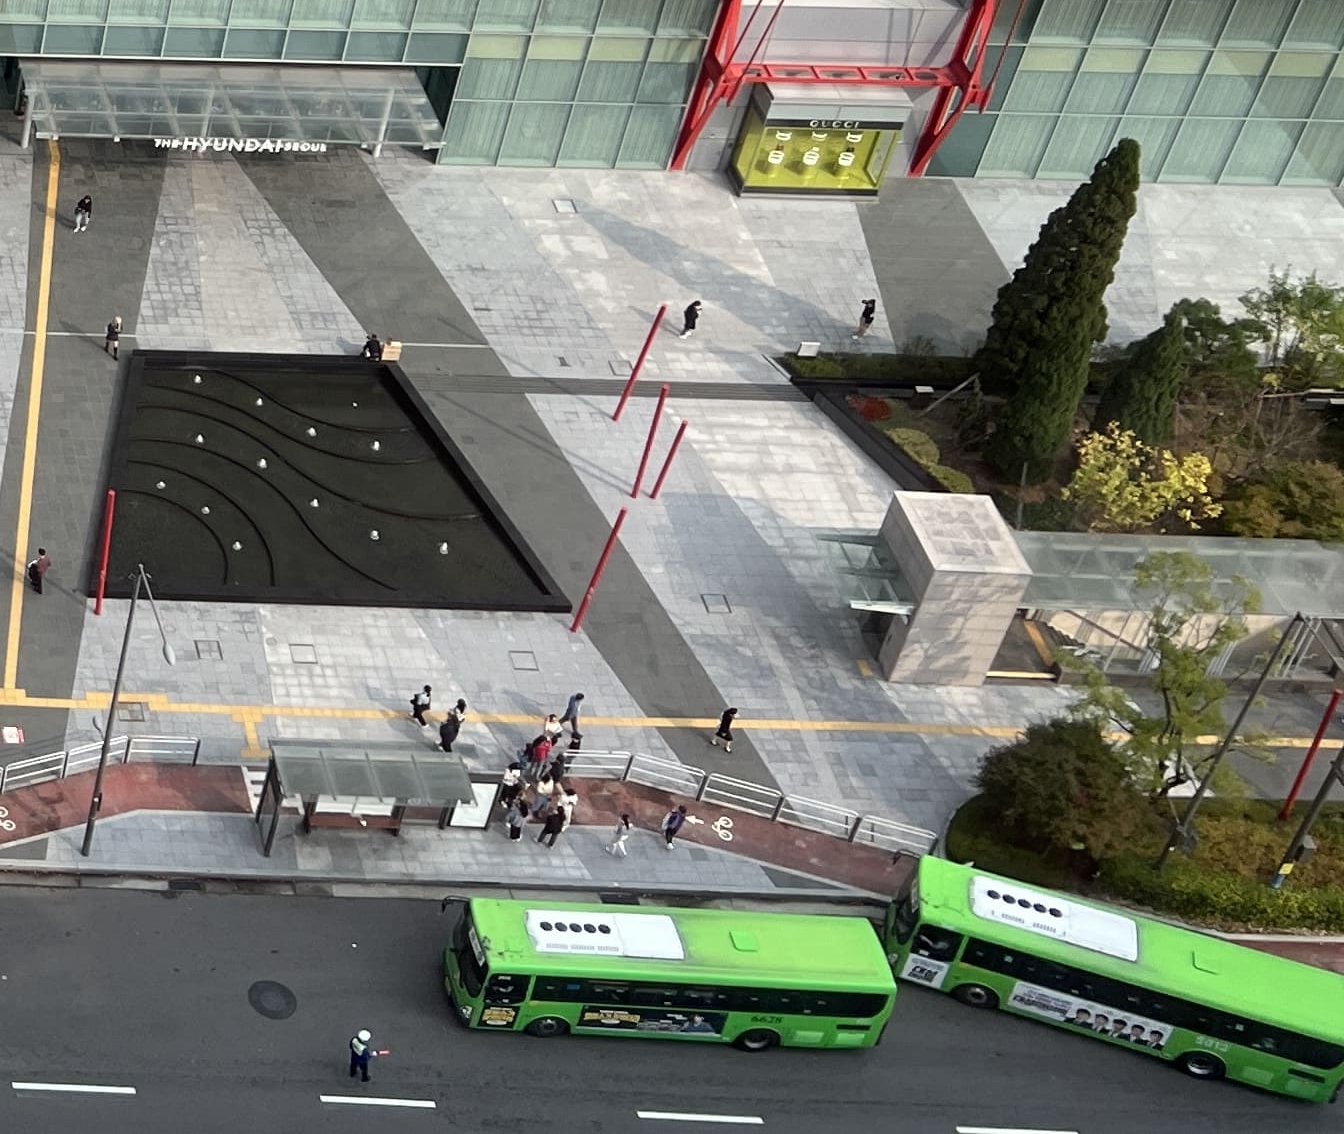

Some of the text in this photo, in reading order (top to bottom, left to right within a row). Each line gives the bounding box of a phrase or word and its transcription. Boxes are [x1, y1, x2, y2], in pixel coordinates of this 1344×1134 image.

[809, 119, 860, 129] GUCCI
[154, 137, 327, 153] THE HYUNDAI SEOUL
